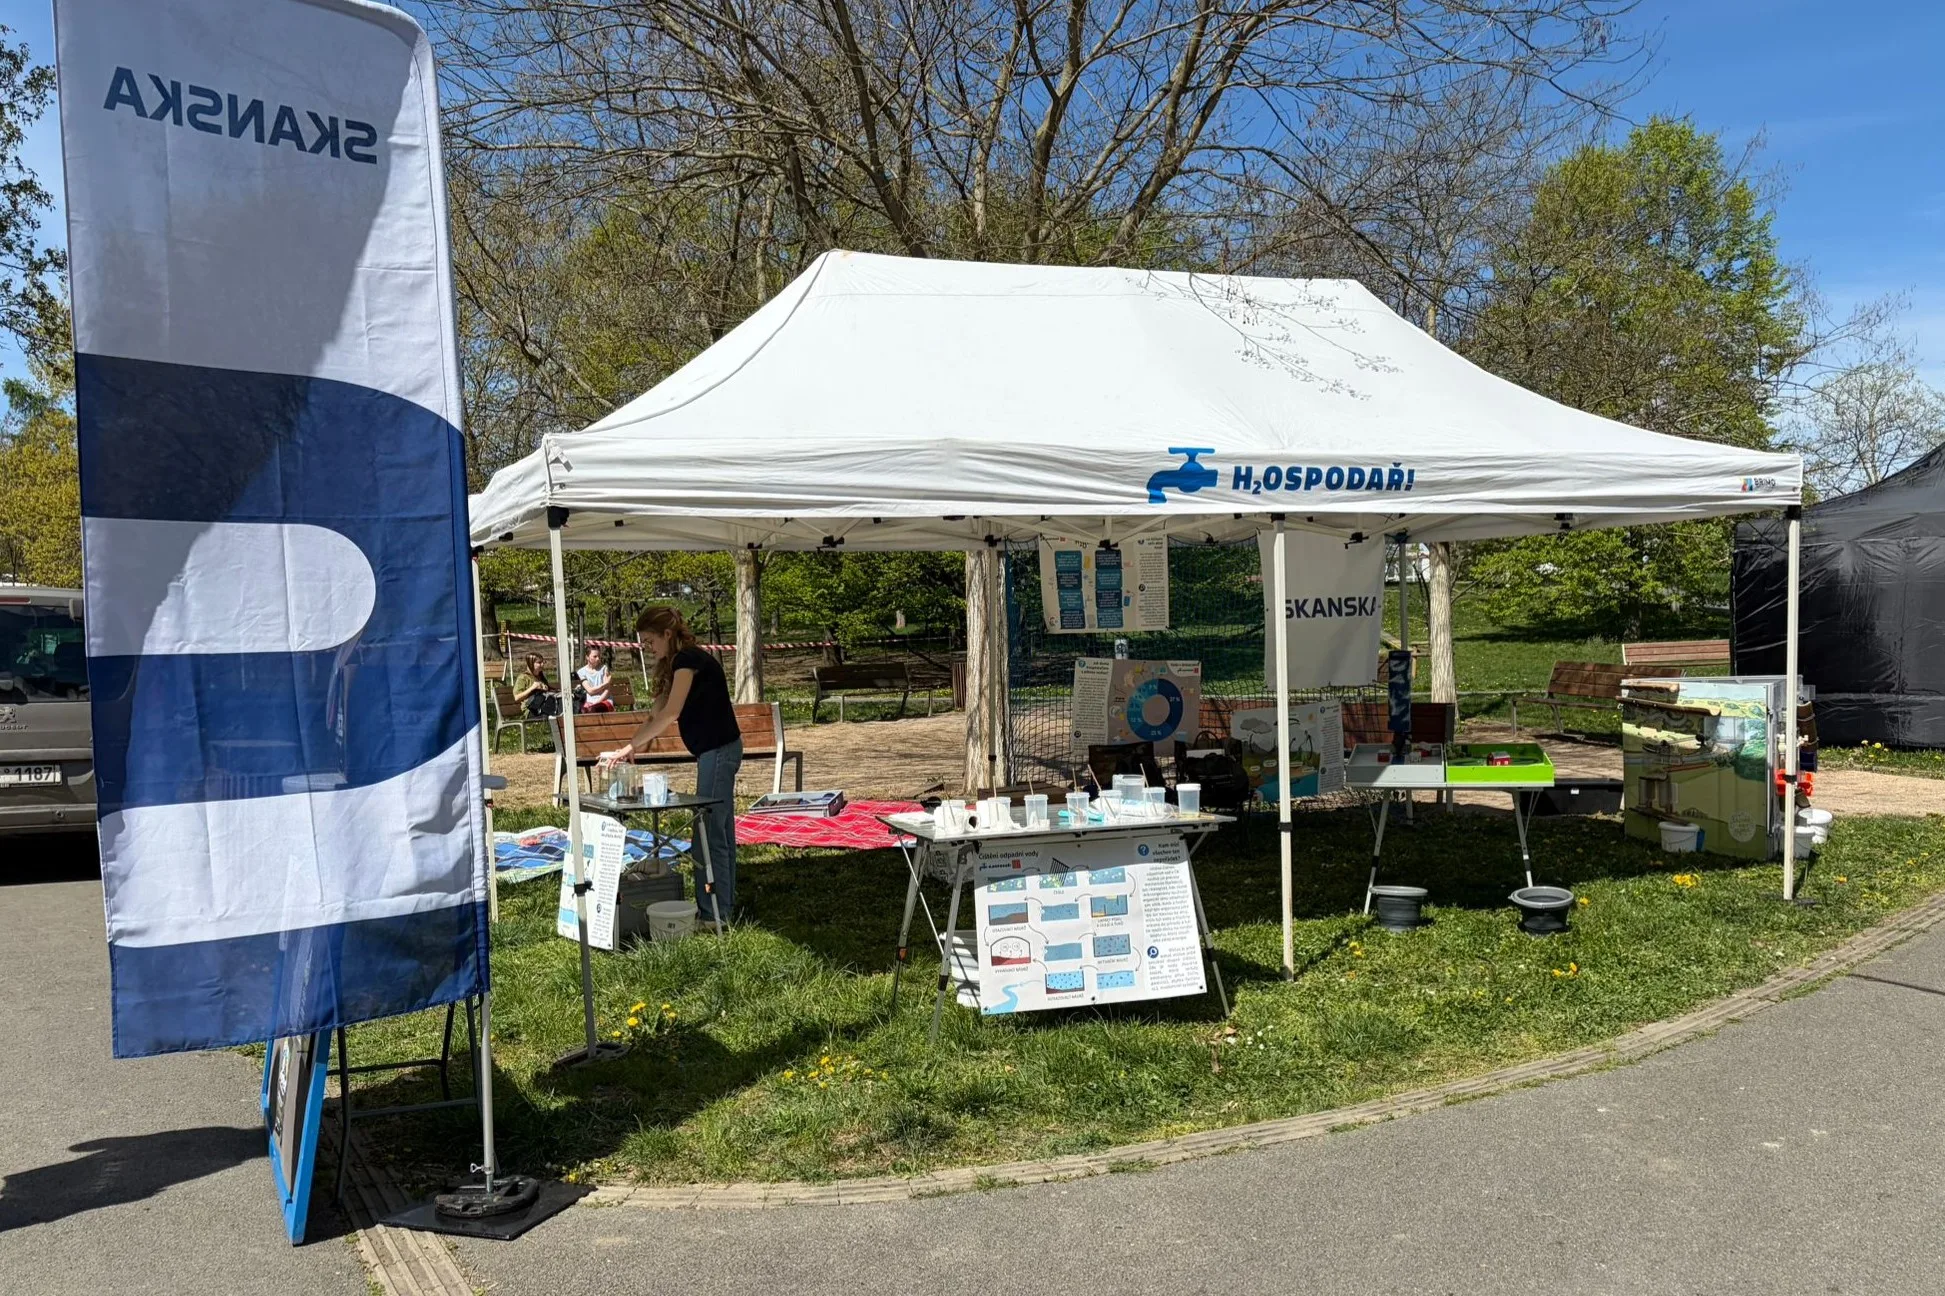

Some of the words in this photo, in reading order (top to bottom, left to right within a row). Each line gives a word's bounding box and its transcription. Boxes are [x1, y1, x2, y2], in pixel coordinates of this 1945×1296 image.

[14, 766, 53, 782] 1187
[1000, 851, 1024, 860] odpadní
[1025, 850, 1039, 858] vody
